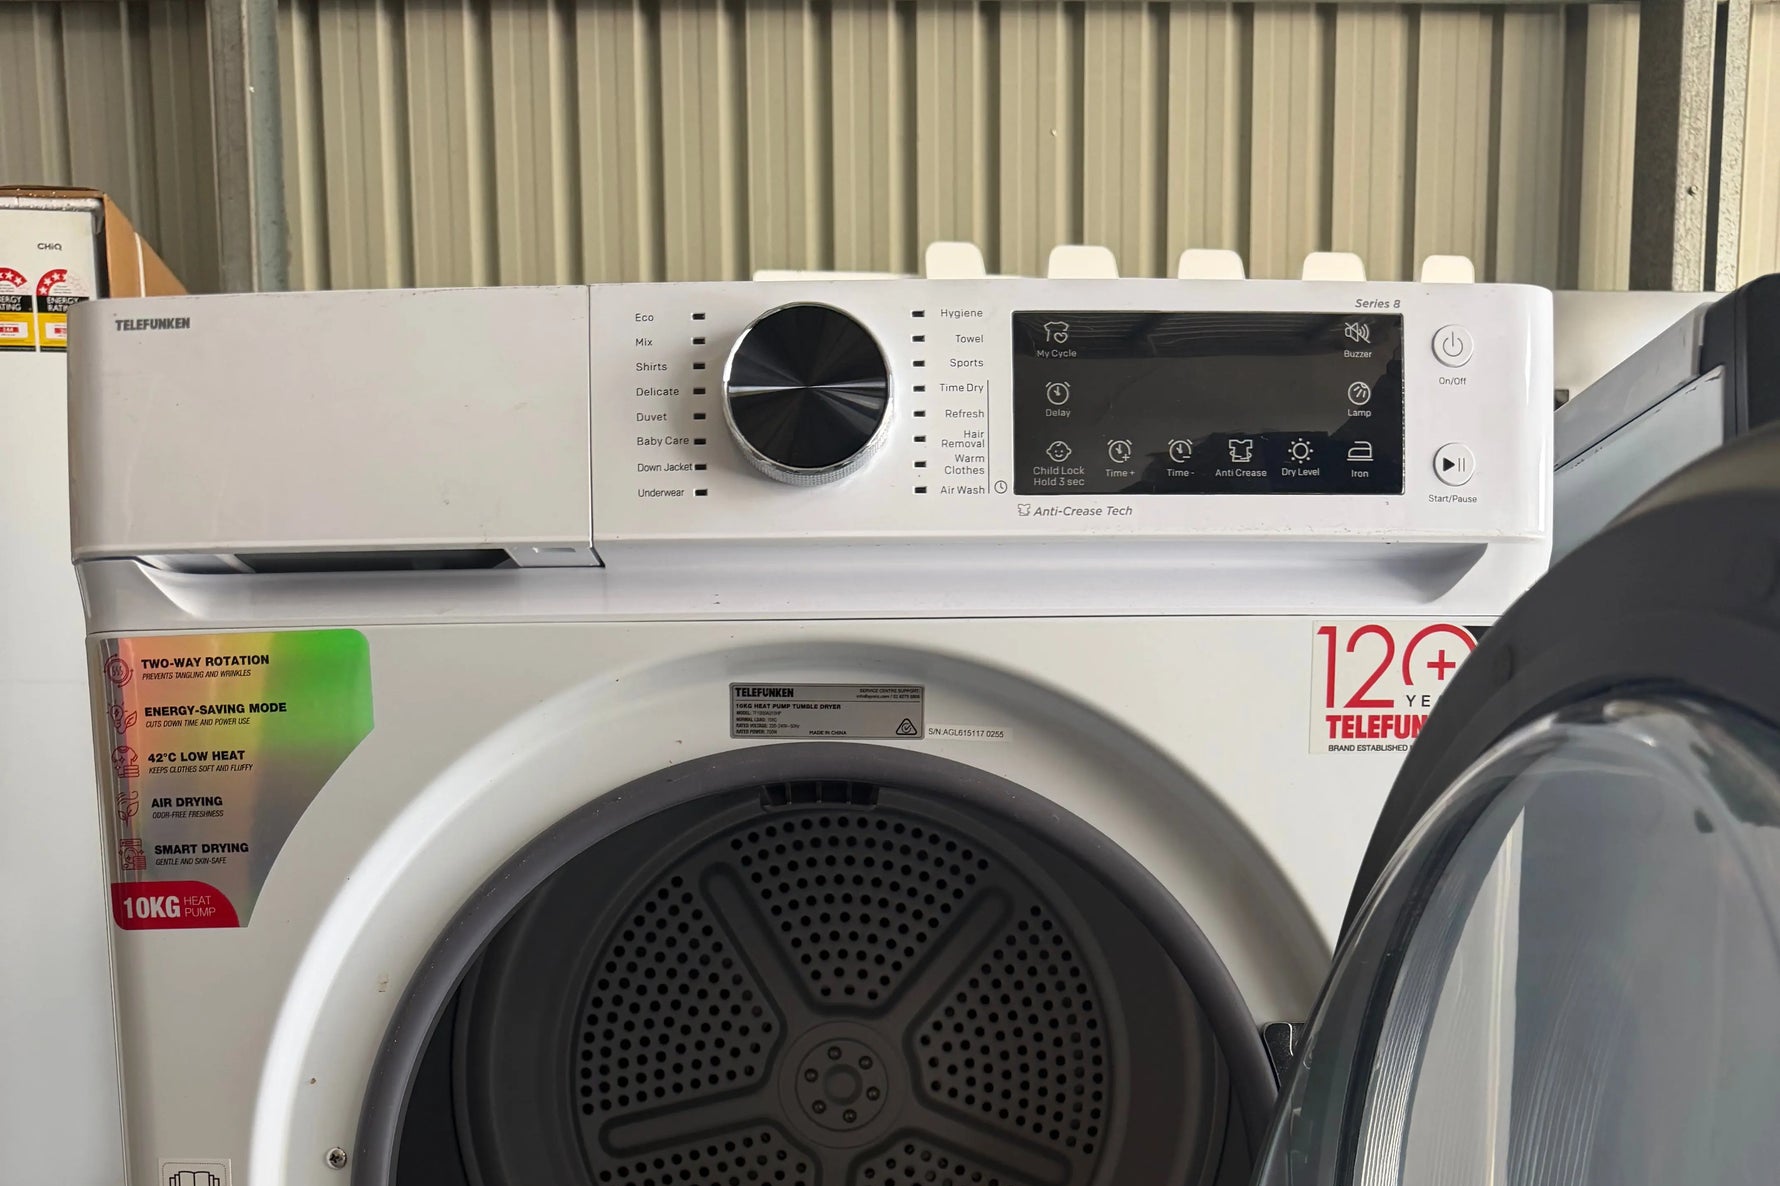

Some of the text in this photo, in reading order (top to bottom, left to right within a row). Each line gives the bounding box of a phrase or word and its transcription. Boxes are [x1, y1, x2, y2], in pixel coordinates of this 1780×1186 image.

[1354, 298, 1401, 309] Series 8
[635, 313, 654, 322] Eco
[940, 308, 984, 319] Hygiene
[115, 317, 191, 331] TELEFUNKEN
[635, 338, 653, 347] Mix
[955, 334, 984, 344] Towel
[1036, 349, 1077, 360] My Cycle
[1343, 350, 1372, 359] Buzzer
[635, 362, 668, 372] Shirts
[950, 358, 984, 369] Sports
[1438, 376, 1467, 386] On/Off
[636, 387, 680, 397] Delicate
[939, 383, 984, 395] Time Dry
[636, 412, 668, 422] Duvet
[945, 409, 985, 419] Refresh
[1045, 409, 1071, 419] Delay
[1347, 409, 1372, 419] Lamp
[963, 429, 984, 439] Hair
[637, 436, 690, 447] Baby Care
[941, 439, 985, 449] Removal
[955, 454, 985, 464] Warm
[637, 462, 693, 473] Down Jacket
[944, 465, 985, 475] Clothes
[1033, 466, 1085, 476] Child Lock
[1105, 468, 1127, 478] Time
[1166, 468, 1188, 478] Time
[1215, 468, 1267, 478] Anti Crease
[1281, 467, 1320, 479] Dry Level
[1351, 469, 1369, 478] Iron
[1033, 477, 1085, 487] Hold 3 sec
[637, 488, 685, 498] Underwear
[940, 485, 985, 495] Air Wash
[1428, 494, 1477, 504] Start/Pause
[1034, 505, 1133, 517] Anti-Crease Tech
[141, 654, 270, 669] TWO-WAY ROTATION
[142, 669, 252, 680] PREVENTS TANGLING AND WRINKLES
[734, 687, 794, 698] TELEFUNKEN
[145, 702, 287, 717] ENERGY-SAVING MODE
[145, 720, 162, 728] CUTS
[163, 719, 182, 728] DOWN
[182, 719, 199, 727] TIME
[214, 718, 237, 726] POWER
[237, 717, 251, 725] USE
[1325, 714, 1431, 739] TELEFUN
[1328, 744, 1409, 752] BRAND ESTABLISHED
[148, 750, 246, 764] 42°C LOW HEAT
[148, 763, 253, 774] KEEPS CLOTHES SOFT AND FLUFFY
[151, 796, 223, 808] AIR DRYING
[152, 810, 224, 819] ODOR-FREE FRESHNESS
[154, 842, 250, 855] SMART DRYING
[155, 856, 227, 866] GENTLE AND SKIN-SAFE
[183, 895, 212, 906] HEAT
[123, 894, 182, 919] 10KG
[184, 906, 216, 918] PUMP
